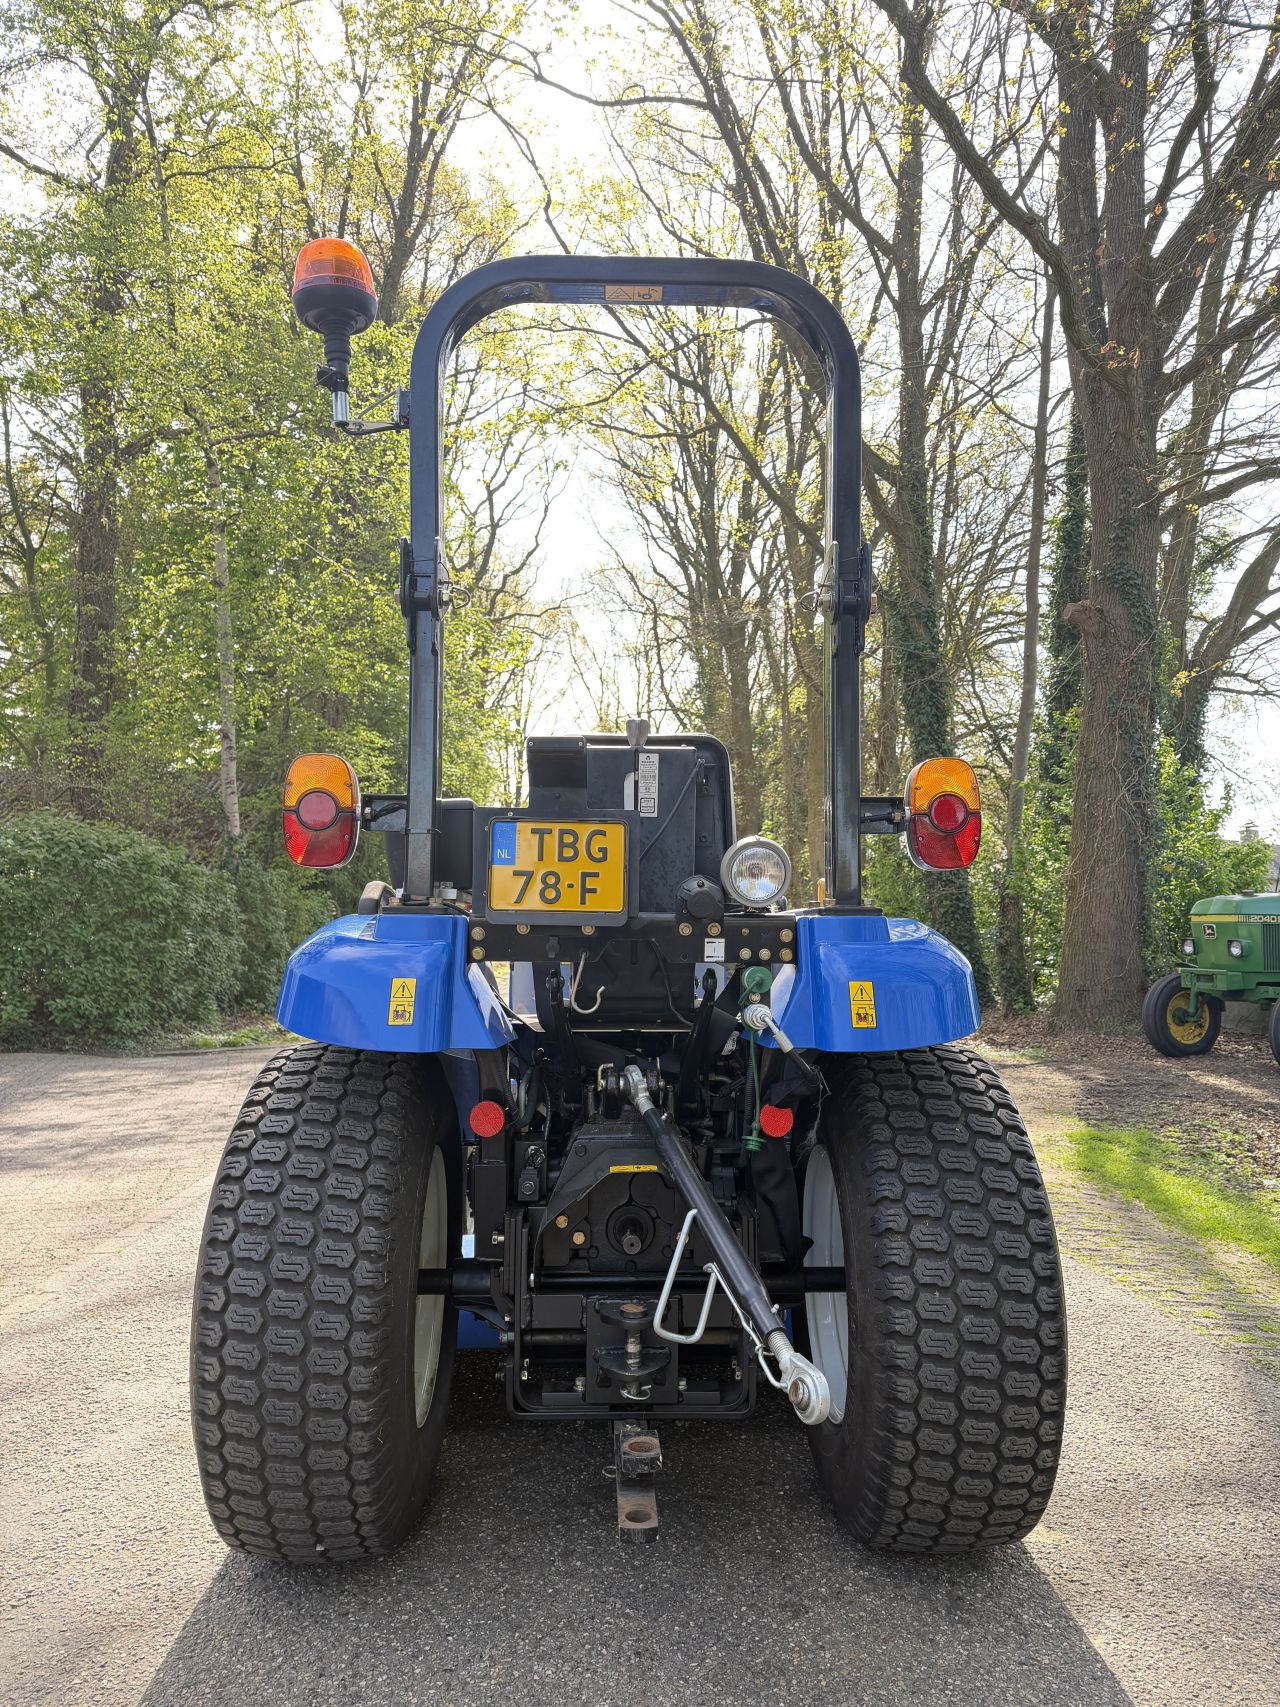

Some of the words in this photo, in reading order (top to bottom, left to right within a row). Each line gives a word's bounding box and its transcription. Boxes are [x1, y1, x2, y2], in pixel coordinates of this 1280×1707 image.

[497, 848, 512, 859] NL
[530, 827, 608, 863] TBG
[512, 869, 600, 905] 78-F
